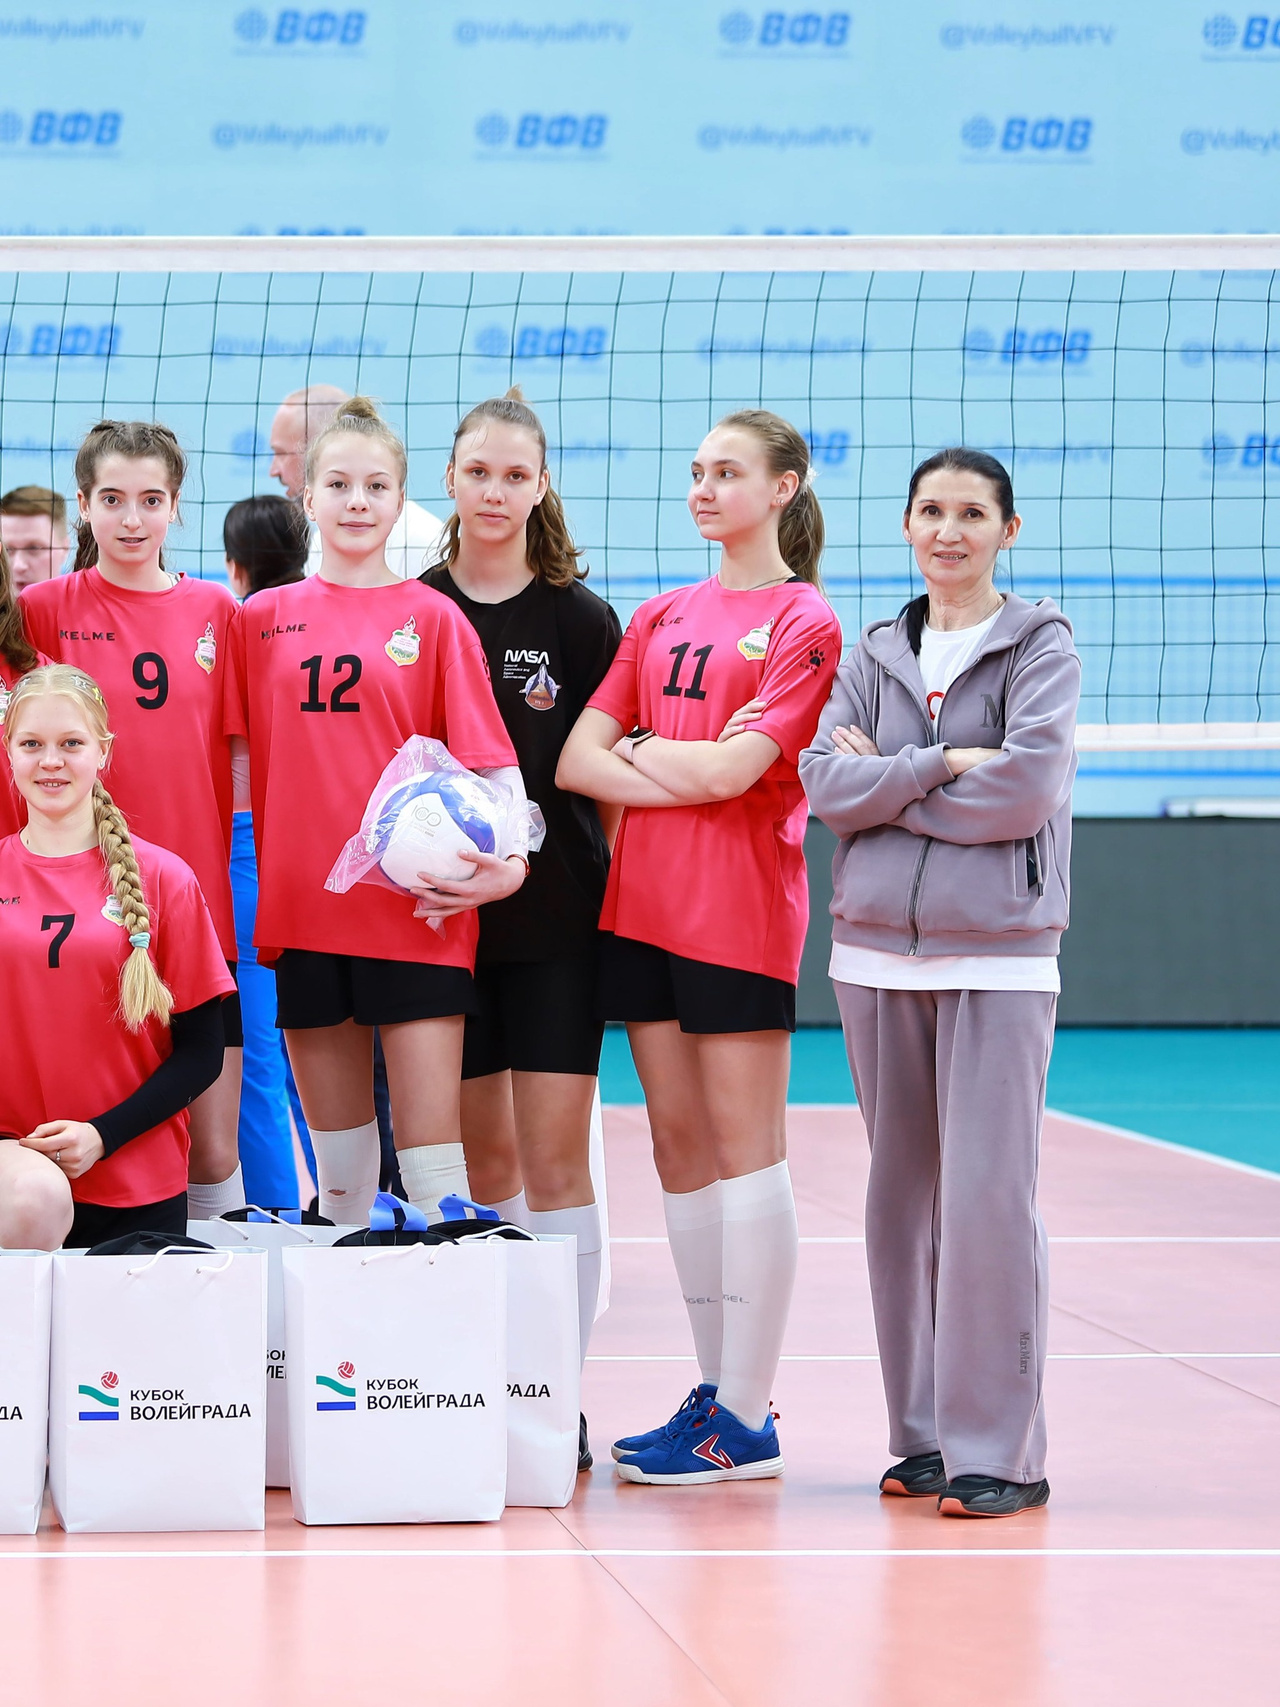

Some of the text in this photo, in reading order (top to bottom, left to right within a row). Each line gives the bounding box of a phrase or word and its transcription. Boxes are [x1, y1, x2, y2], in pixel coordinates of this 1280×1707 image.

[59, 629, 116, 641] KELME
[504, 649, 550, 665] NASA
[133, 653, 168, 709] 9
[663, 643, 712, 700] 11
[301, 655, 361, 712] 12
[42, 914, 74, 968] 7
[366, 1378, 419, 1391] КУБОК
[130, 1389, 184, 1401] КУБОК
[366, 1391, 486, 1410] ВОЛЕЙГРАДА
[130, 1401, 251, 1421] ВОЛЕЙГРАДА
